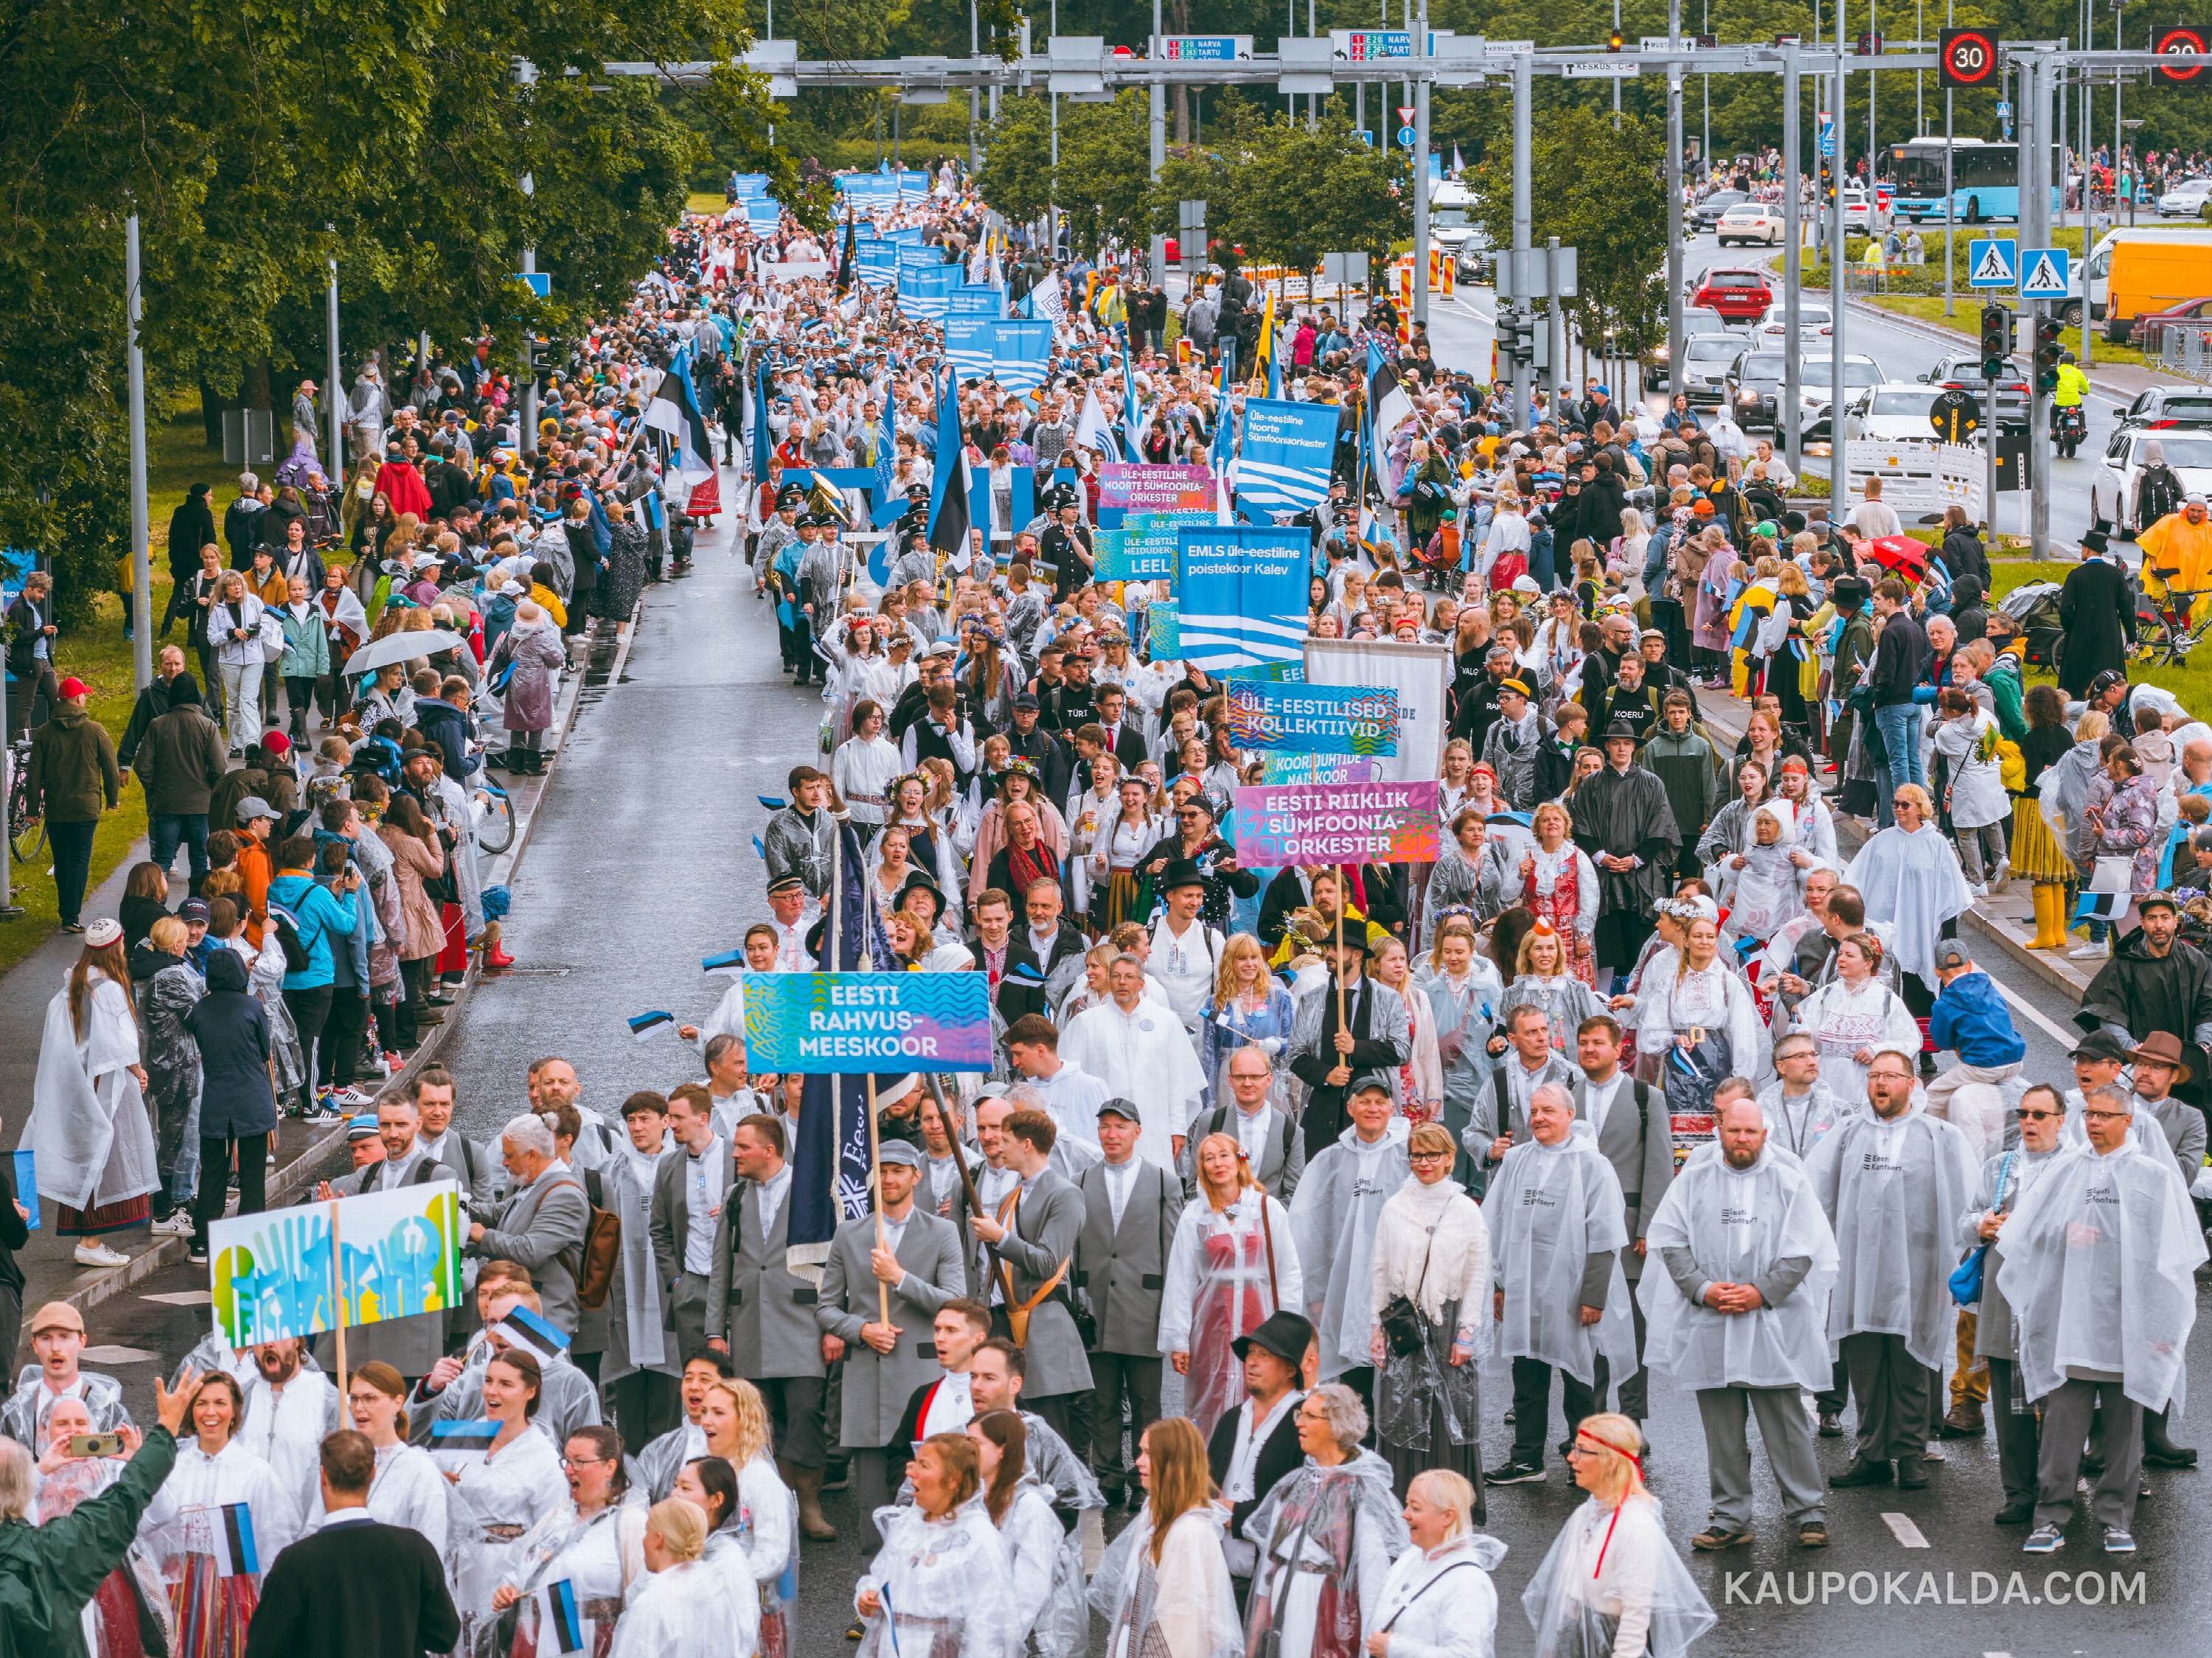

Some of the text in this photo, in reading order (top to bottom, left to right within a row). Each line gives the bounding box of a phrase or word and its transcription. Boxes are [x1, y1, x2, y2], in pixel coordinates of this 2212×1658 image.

[1388, 46, 1410, 54] TART
[1955, 47, 1983, 68] 30
[1250, 410, 1304, 425] Üle-eestiline
[1249, 422, 1280, 433] Noorte
[1248, 432, 1327, 448] Sümfooniaorkester
[1121, 468, 1187, 480] ÜLE-EESTILINE
[1105, 481, 1203, 492] NOORTE SÜMFOONIA-
[1417, 481, 1433, 498] VANS
[1130, 492, 1178, 502] ORKESTER
[1124, 537, 1178, 546] ÜLE-EESTILI
[1188, 545, 1300, 558] EMLS üle-eestiline
[1131, 559, 1170, 573] LEEL
[1188, 563, 1289, 577] poistekoor Kalev
[1462, 667, 1479, 676] VALG
[1241, 692, 1388, 720] ÜLE-EESTILISED
[1614, 710, 1644, 719] KOERU
[1247, 715, 1380, 737] KOLLEKTIIVID
[1266, 792, 1409, 812] EESTI RIIKLIK
[1269, 813, 1405, 834] SÜMFOONIA-
[1284, 836, 1391, 855] ORKESTER
[831, 986, 900, 1006] EESTI
[810, 1011, 923, 1031] RAHVUS-
[799, 1037, 938, 1056] MEESKOOR
